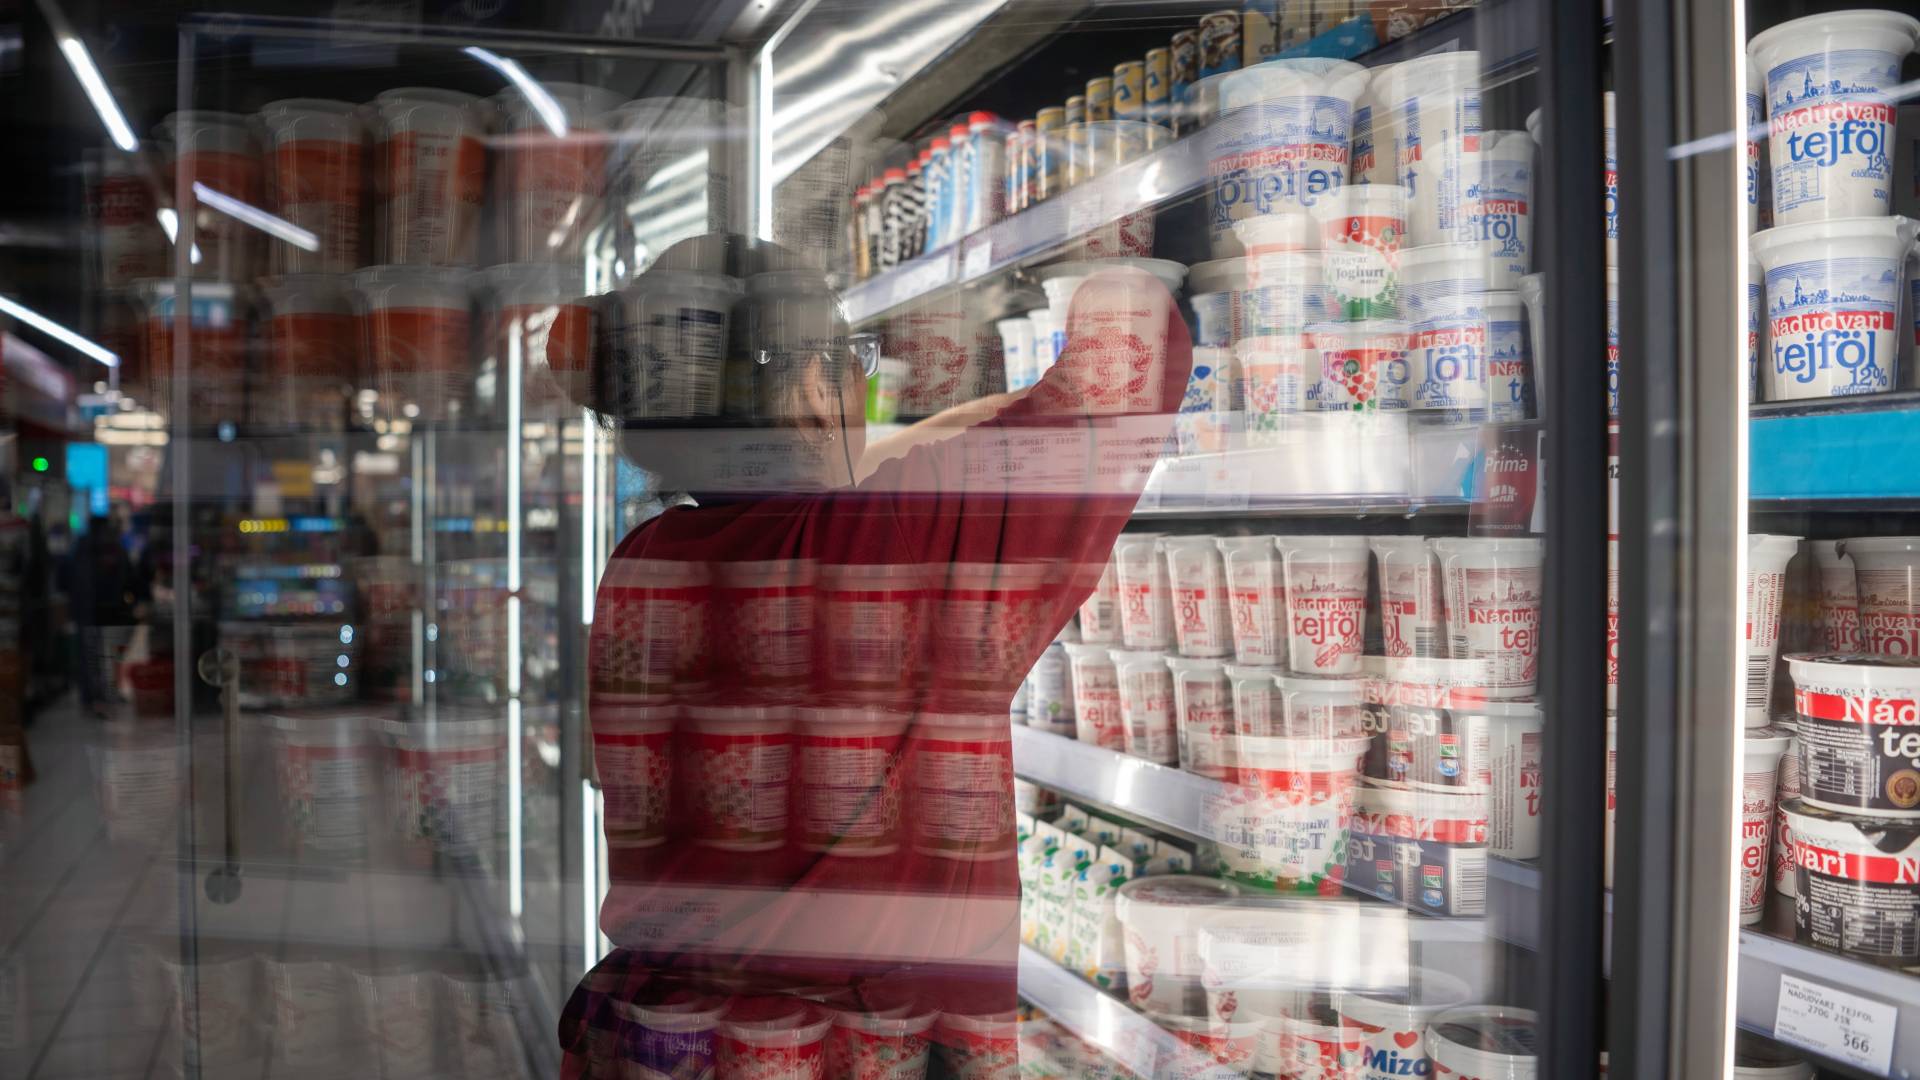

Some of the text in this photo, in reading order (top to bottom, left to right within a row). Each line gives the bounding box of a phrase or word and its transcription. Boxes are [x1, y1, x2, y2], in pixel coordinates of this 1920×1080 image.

[1772, 103, 1890, 136] Nádudvari
[1786, 119, 1887, 167] tejföl
[1867, 154, 1891, 175] 12%
[1771, 311, 1885, 337] Nádudvari
[1774, 329, 1877, 383] tejföl
[1849, 366, 1888, 387] 12%
[1293, 609, 1361, 646] tejföl
[1879, 726, 1920, 768] te
[1844, 1033, 1869, 1054] 566
[1362, 1044, 1432, 1077] Mizo
